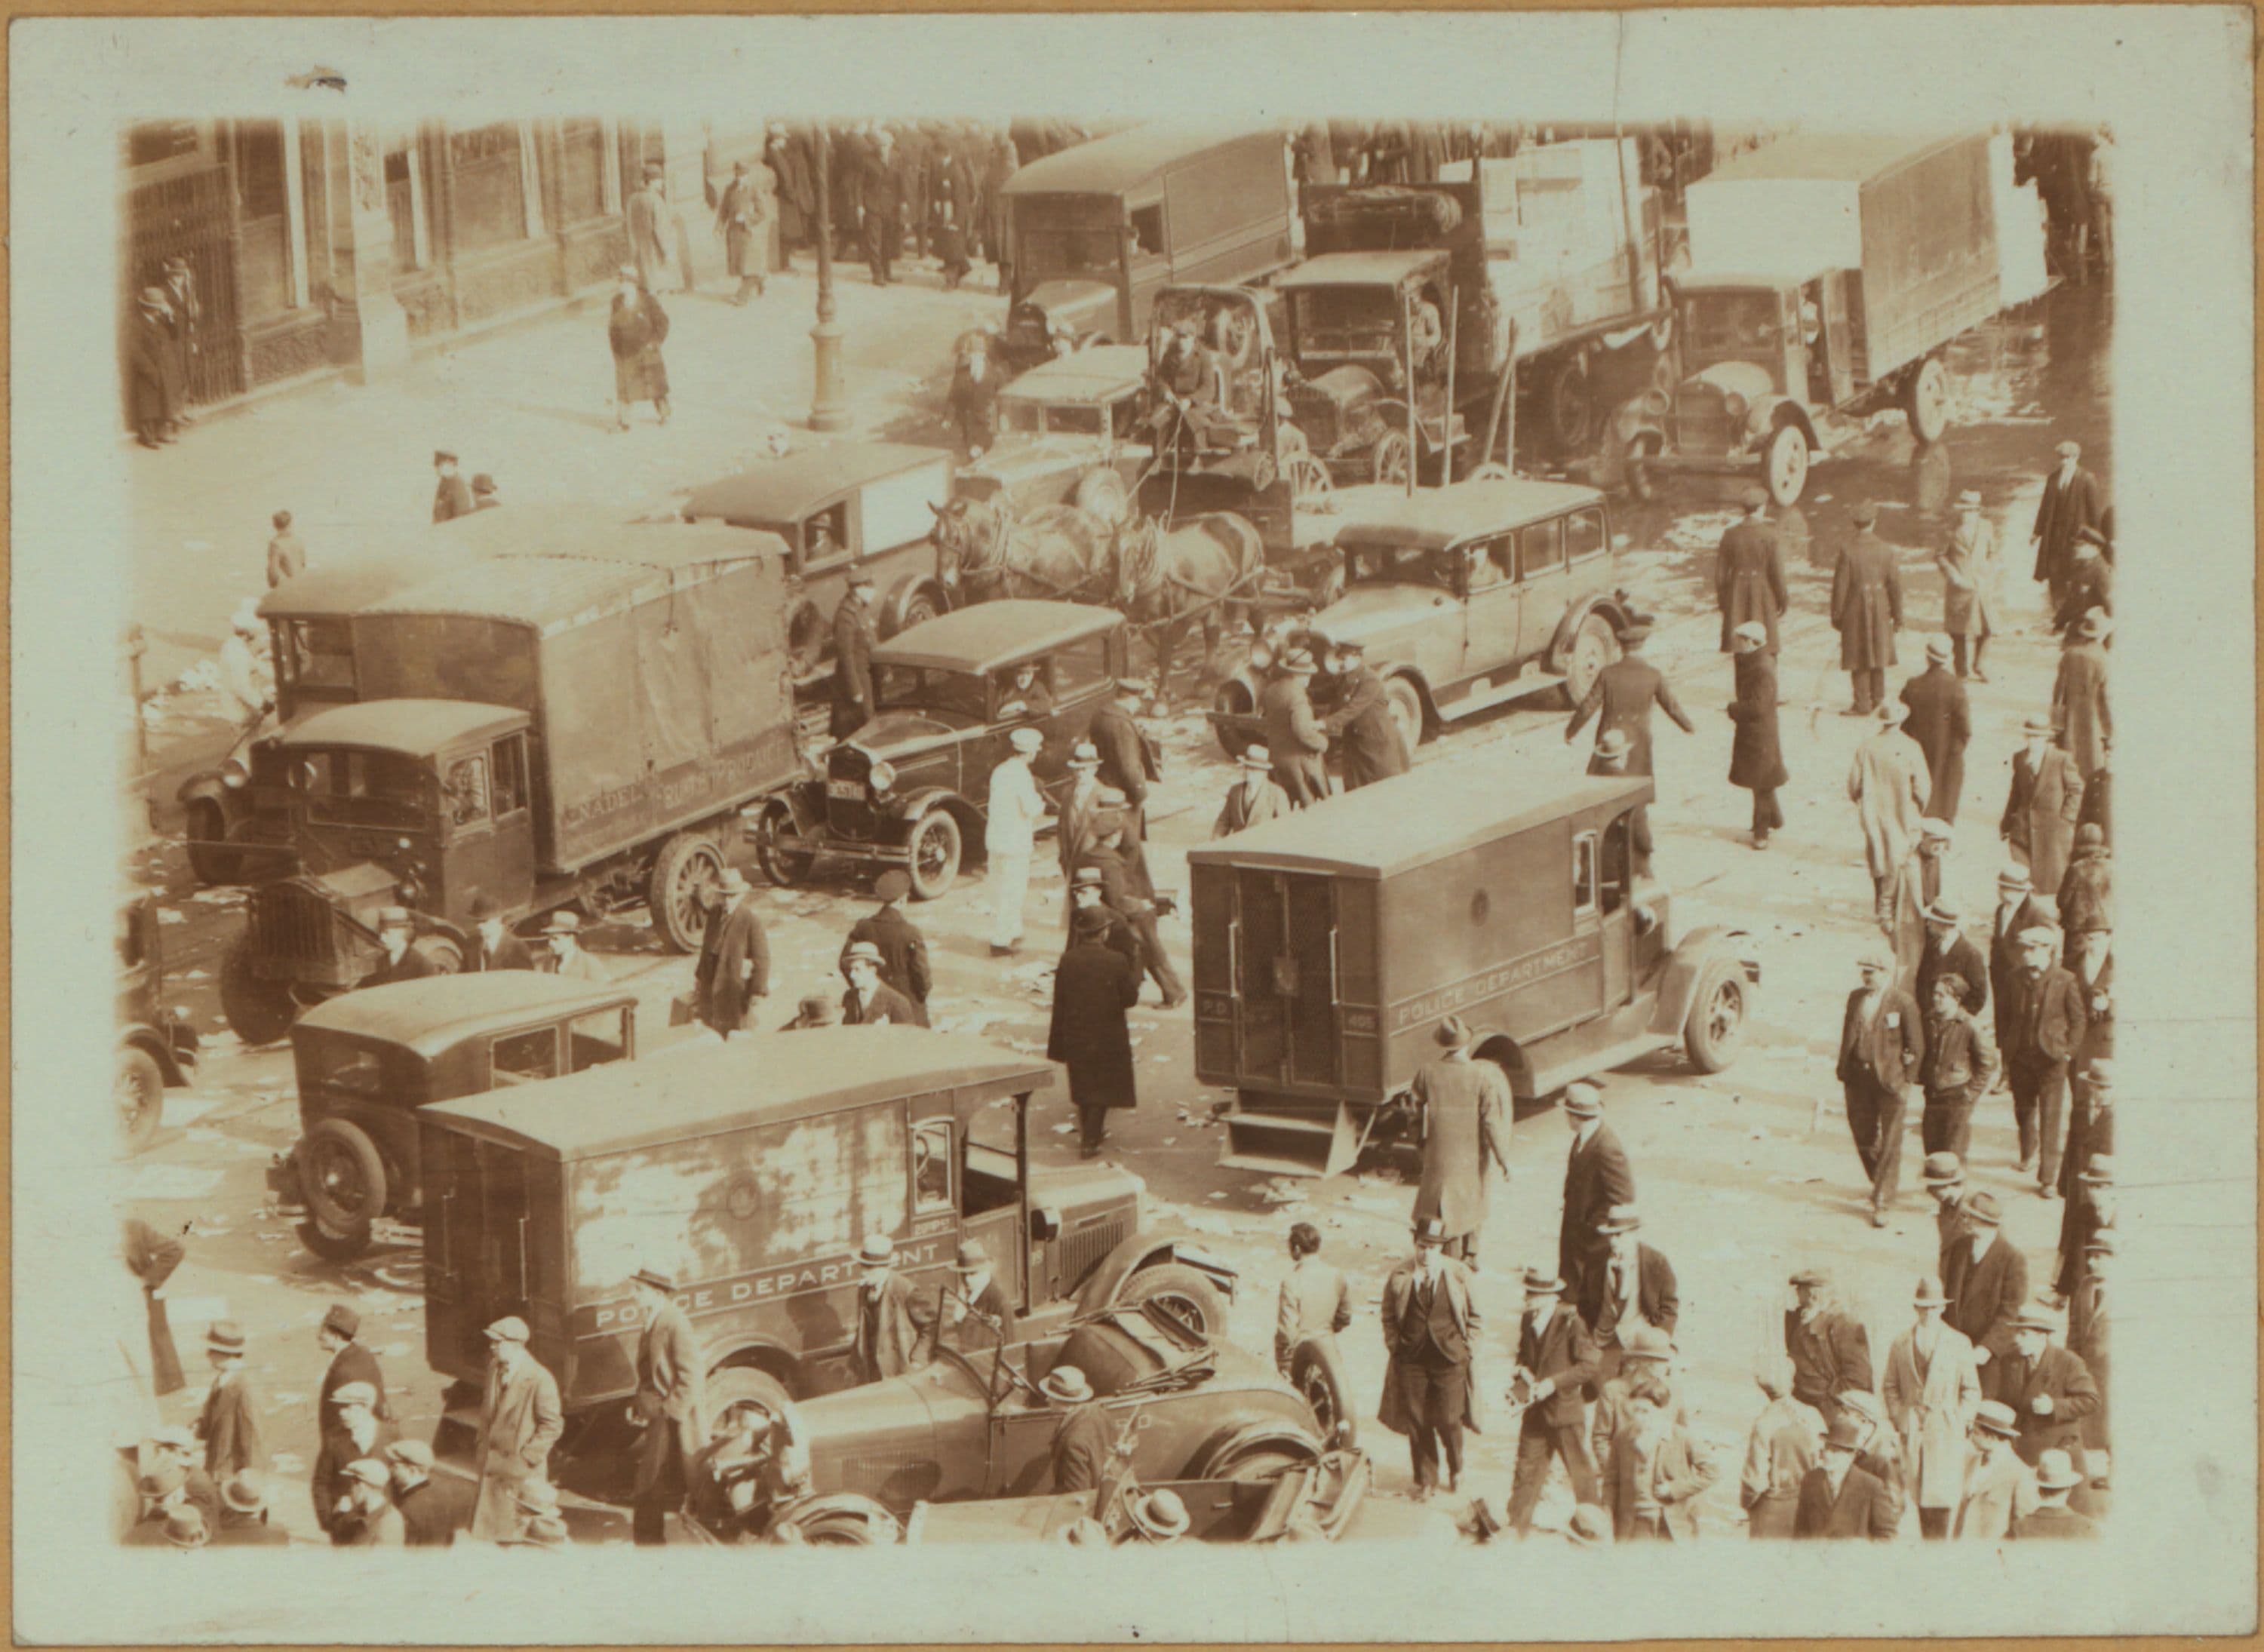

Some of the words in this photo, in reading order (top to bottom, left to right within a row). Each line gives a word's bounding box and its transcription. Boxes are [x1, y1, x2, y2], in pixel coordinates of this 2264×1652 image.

[1399, 987, 1465, 1025] POLICE
[1475, 942, 1589, 996] DEPARTMENT
[596, 1290, 714, 1328] POCE
[731, 1243, 938, 1301] DEPARTNT
